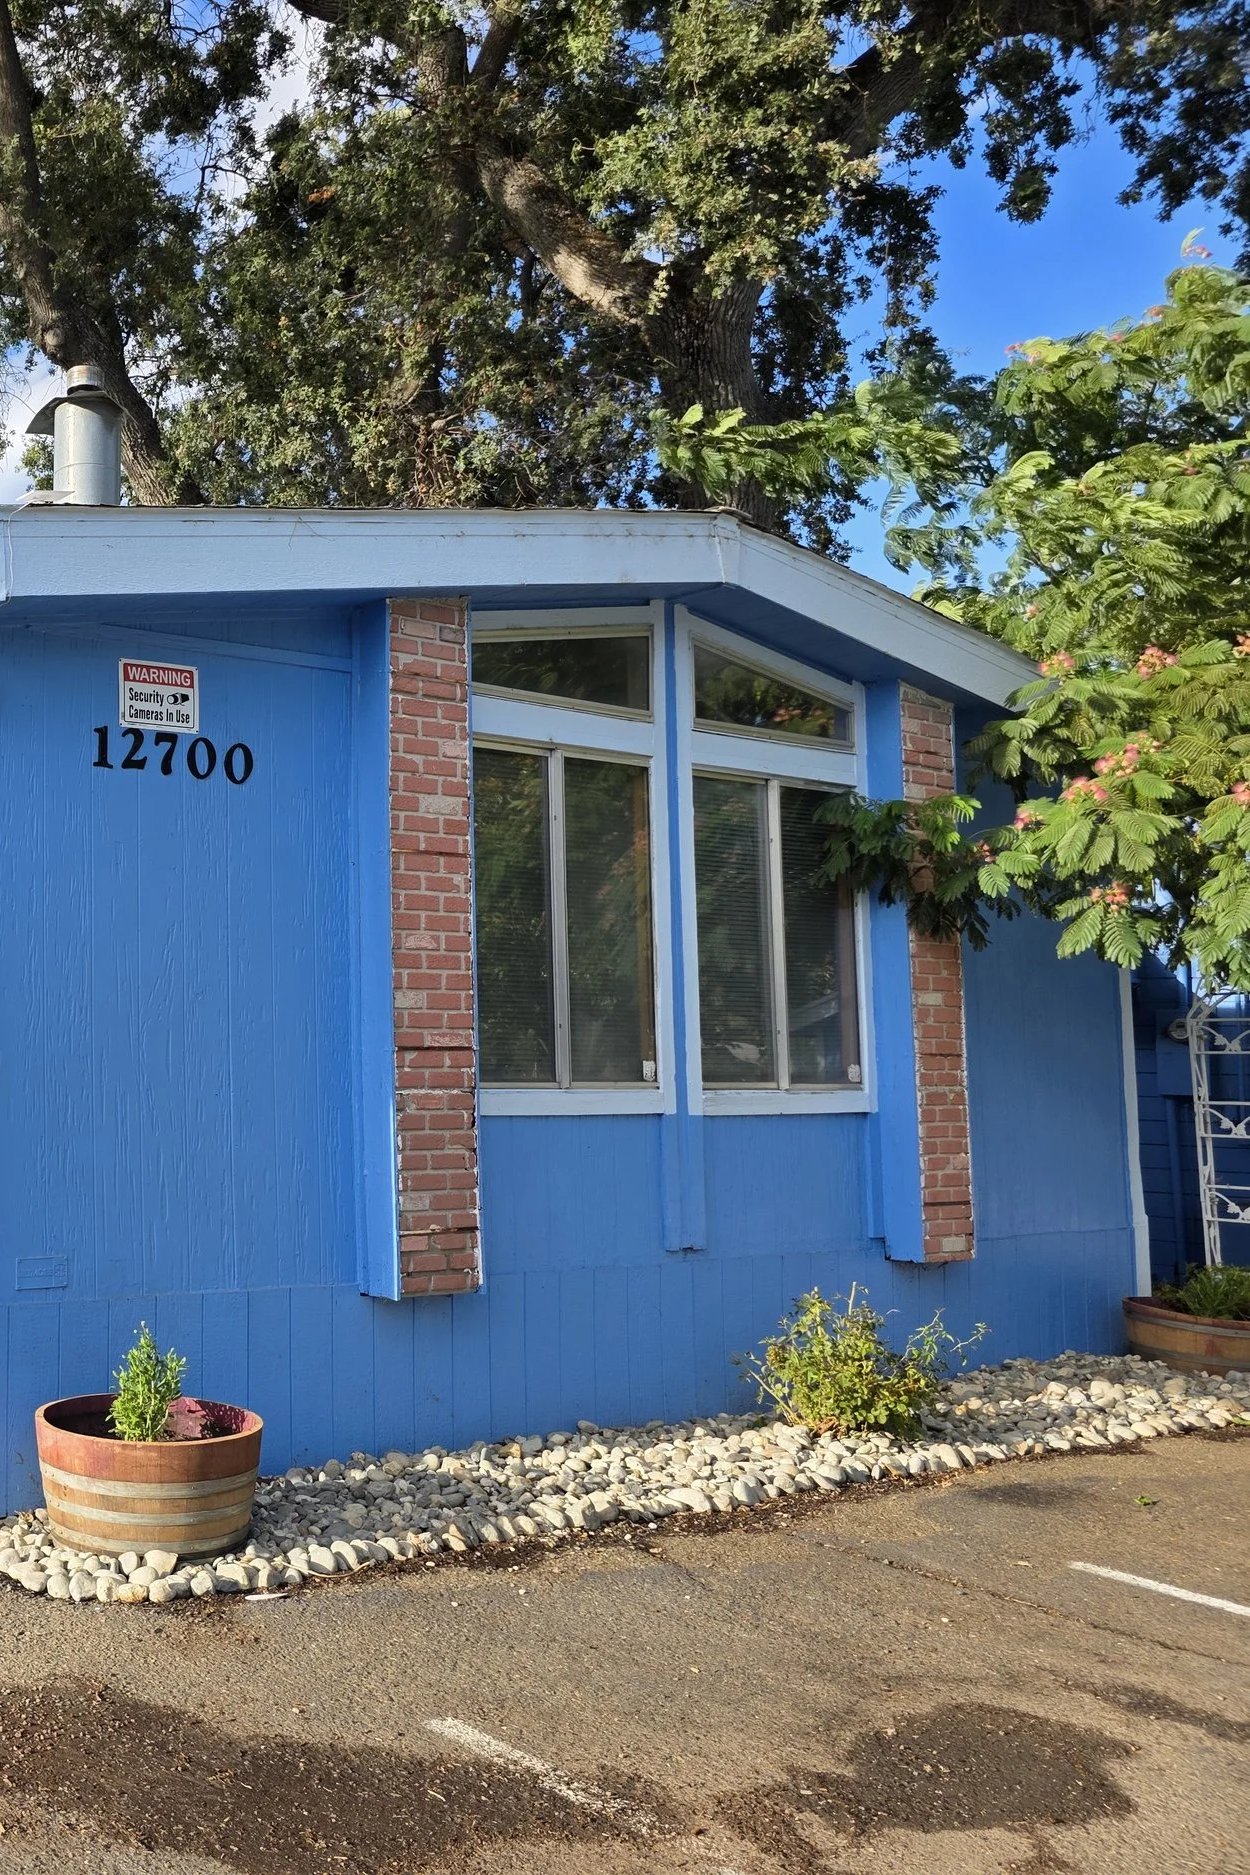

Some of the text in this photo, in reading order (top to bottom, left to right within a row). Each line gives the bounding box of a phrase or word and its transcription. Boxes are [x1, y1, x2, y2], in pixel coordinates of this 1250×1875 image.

[127, 666, 191, 686] WARNING
[128, 687, 165, 707] Security
[128, 704, 164, 722] Cameras
[166, 708, 174, 723] In
[175, 709, 190, 724] Use
[93, 725, 254, 785] 12700
